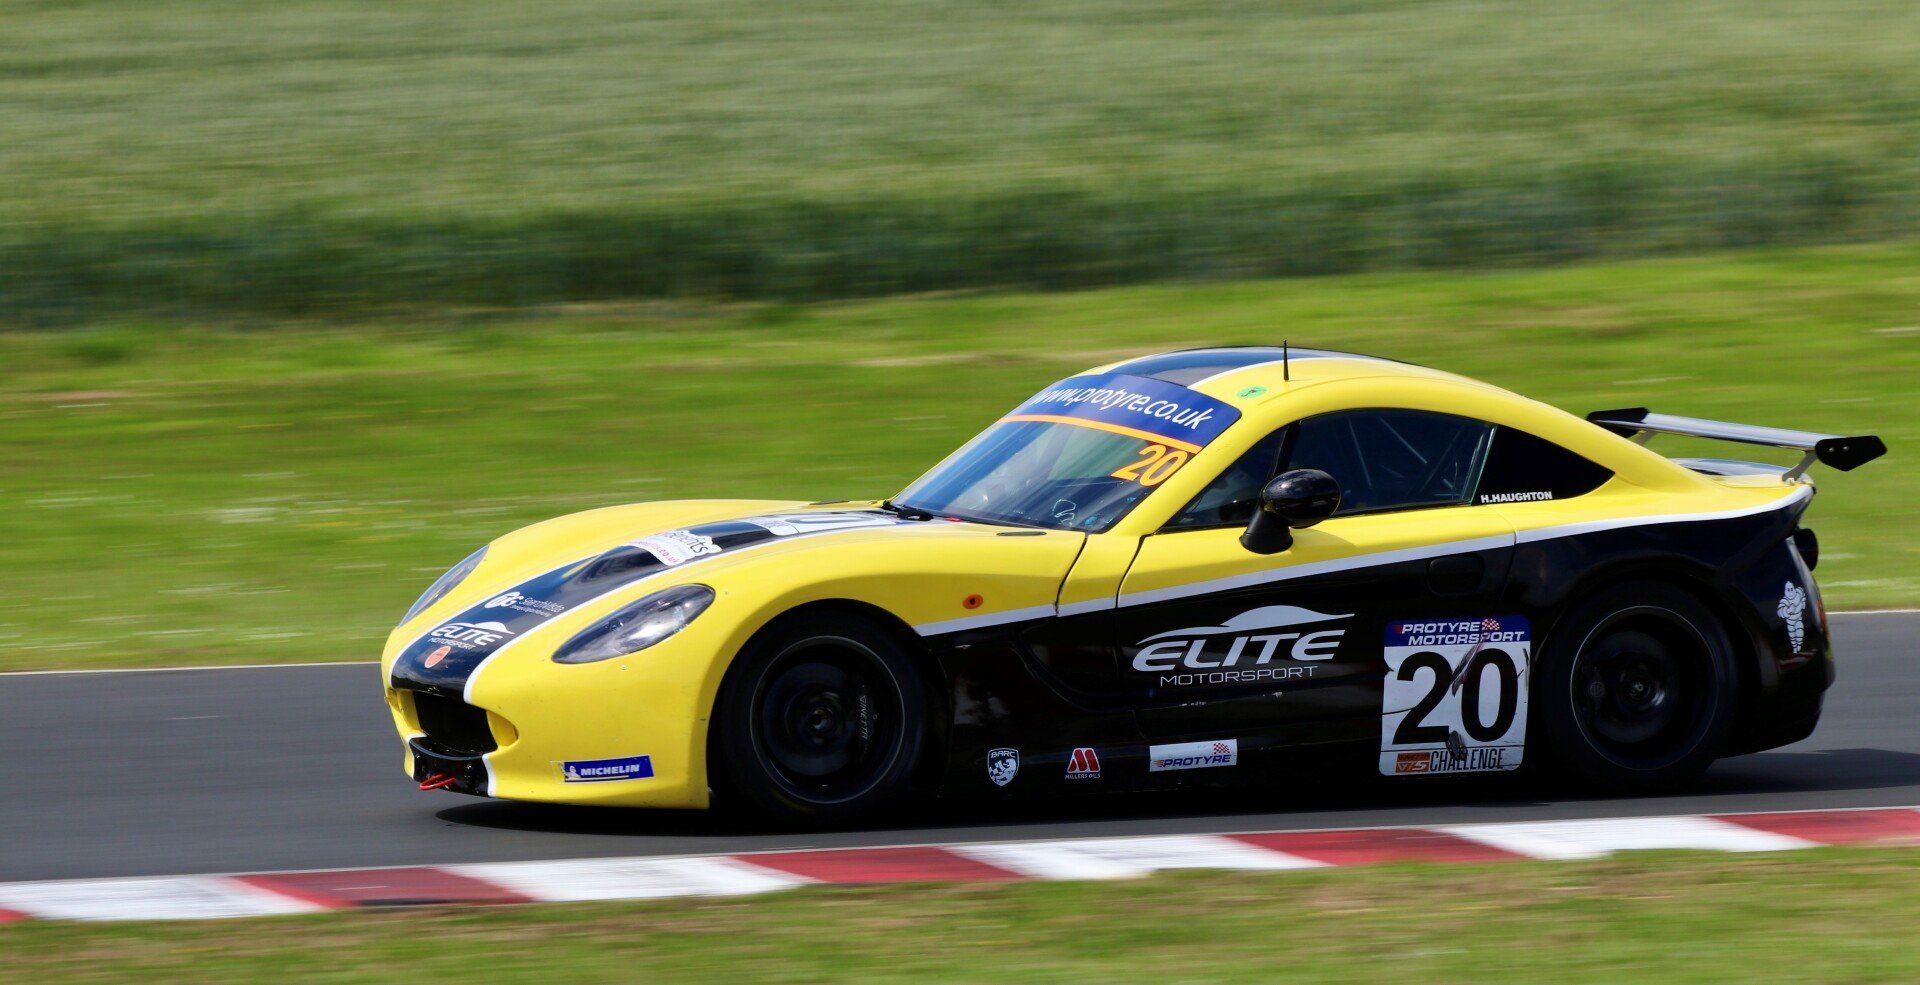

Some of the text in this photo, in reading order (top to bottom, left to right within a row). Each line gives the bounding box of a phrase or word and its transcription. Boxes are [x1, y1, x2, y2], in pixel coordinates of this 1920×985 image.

[1031, 388, 1214, 430] www.protyre.co.uk
[1110, 444, 1188, 487] 20
[1480, 491, 1553, 504] H.HAUGHTON
[430, 625, 503, 646] ELITE
[1402, 621, 1481, 634] PROTYRE
[1408, 631, 1525, 646] MOTORSPORT
[1132, 630, 1346, 672] ELITE
[1160, 666, 1319, 686] MOTORSPORT
[1392, 648, 1519, 745] 20
[990, 750, 1016, 759] BARC
[1163, 754, 1232, 767] PROTYRE
[580, 764, 640, 776] MICHELIN
